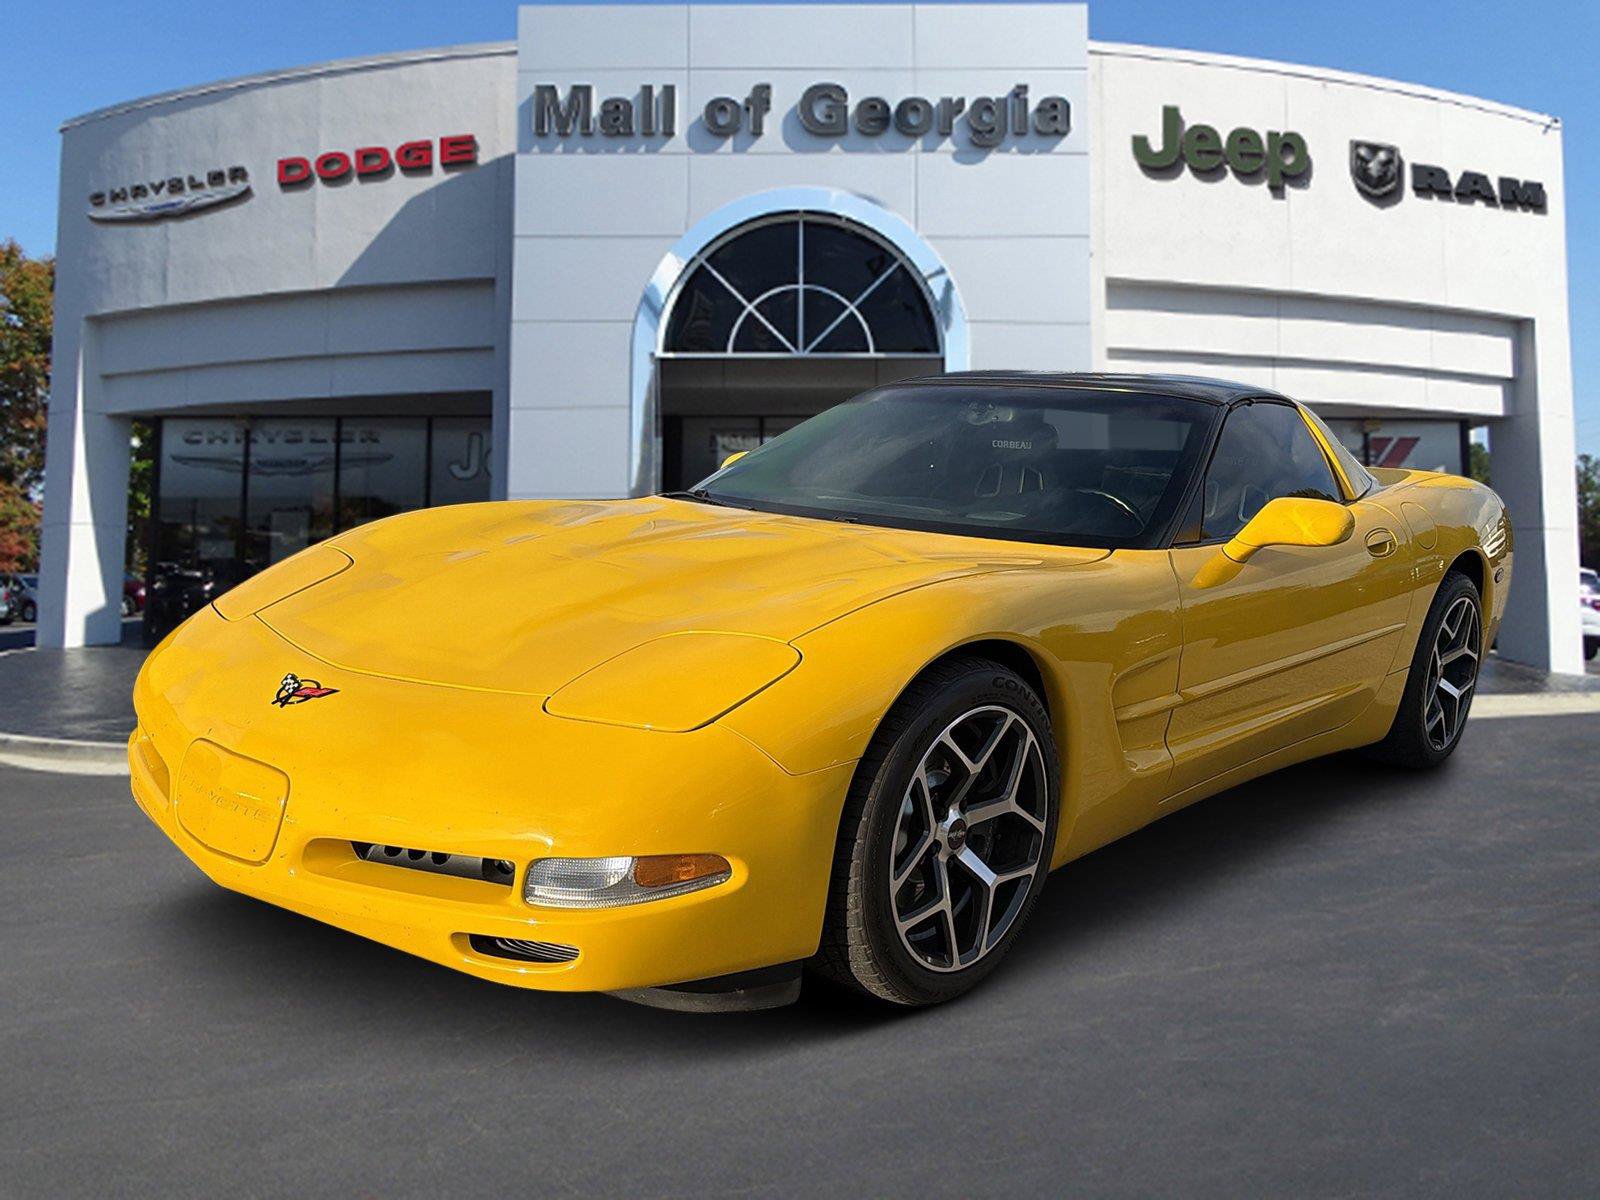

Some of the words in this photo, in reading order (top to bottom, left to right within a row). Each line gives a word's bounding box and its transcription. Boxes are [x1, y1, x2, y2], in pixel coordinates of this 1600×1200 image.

[532, 84, 677, 138] Mall
[704, 83, 772, 138] of
[799, 82, 1073, 149] Georgia
[277, 134, 477, 186] DODGE
[1132, 104, 1309, 188] Jeep
[89, 165, 249, 207] CHRYSLER
[1410, 162, 1546, 212] RAM
[992, 440, 1032, 450] CORBEAU
